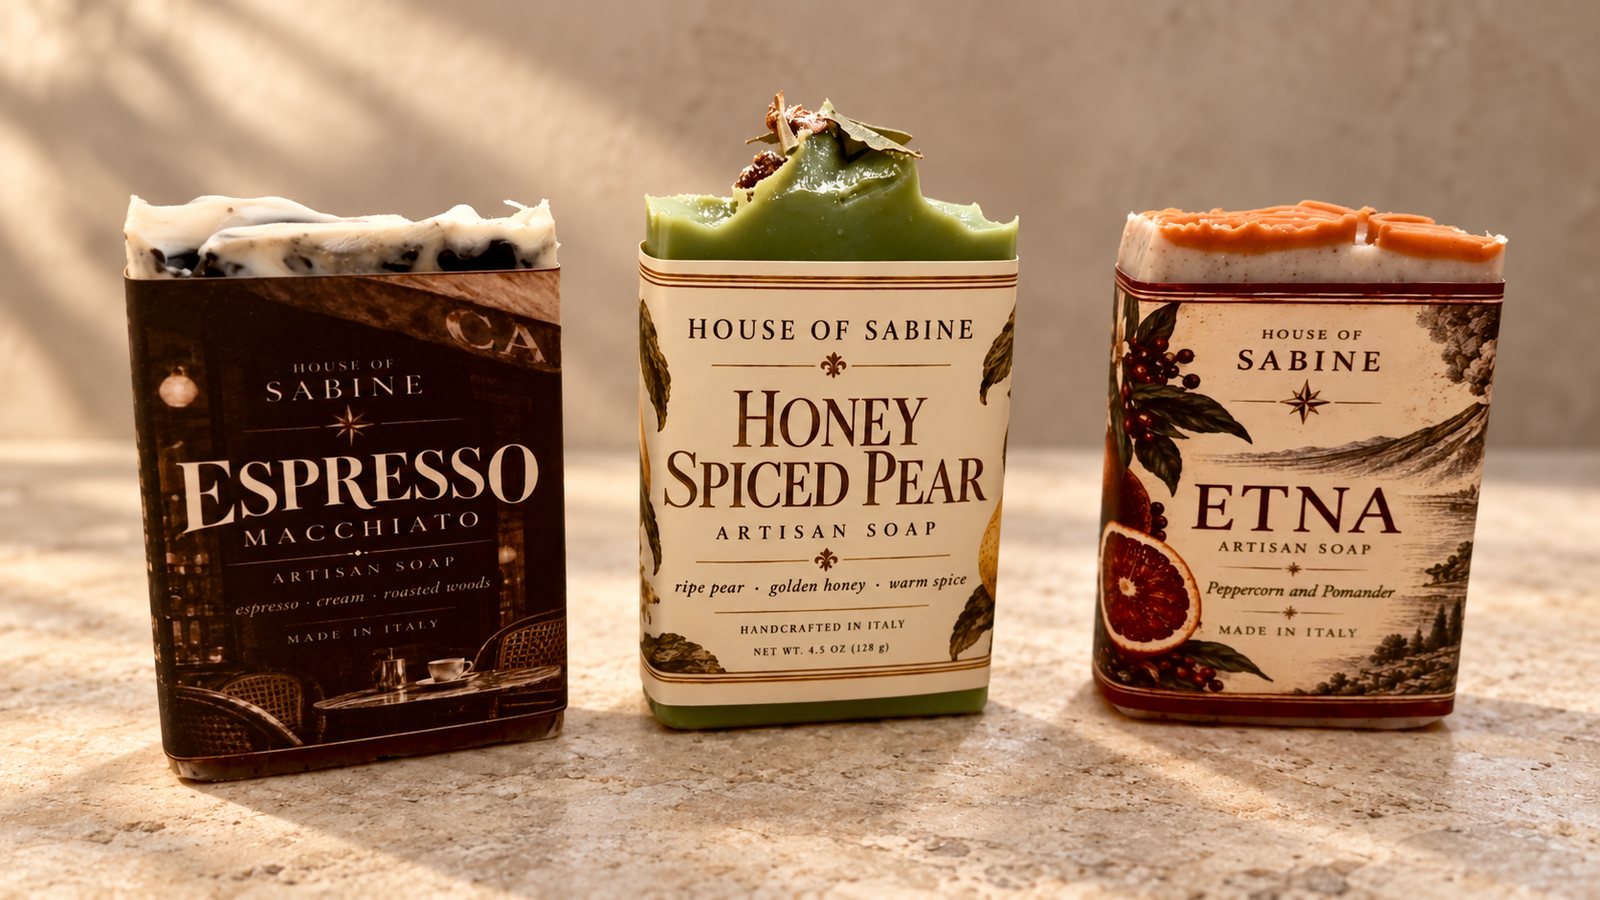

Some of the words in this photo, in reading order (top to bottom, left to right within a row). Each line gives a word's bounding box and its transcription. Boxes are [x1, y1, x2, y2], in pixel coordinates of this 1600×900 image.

[688, 318, 795, 340] HOUSE
[810, 320, 850, 340] OF
[865, 319, 974, 341] SABINE
[1262, 329, 1327, 340] HOUSE
[1337, 330, 1362, 341] OF
[293, 360, 361, 374] HOUSE
[370, 359, 396, 370] OF
[1237, 349, 1381, 372] SABINE
[265, 375, 424, 402] SABINE
[732, 390, 928, 447] HONEY
[176, 444, 539, 534] ESPRESSO
[664, 450, 849, 509] SPICED
[862, 451, 987, 506] PEAR
[1191, 483, 1402, 534] ETNA
[244, 511, 479, 548] MACCHIATO
[715, 524, 846, 540] ARTISAN
[867, 522, 937, 537] SOAP
[1218, 541, 1307, 554] ARTISAN
[1319, 542, 1372, 555] SOAP
[272, 563, 381, 585] ARTISAN
[396, 556, 456, 573] SOAP
[674, 580, 705, 596] ripe
[709, 582, 745, 596] pear
[769, 578, 818, 597] golden
[824, 578, 866, 594] honey
[889, 576, 928, 588] warm
[933, 573, 967, 588] spice
[1206, 581, 1285, 599] Peppercorn
[1289, 583, 1318, 598] and
[1321, 585, 1395, 599] Pomander
[235, 598, 300, 618] espresso
[316, 593, 365, 607] cream
[383, 581, 440, 600] roasted
[446, 576, 491, 592] woods
[287, 628, 341, 644] MADE
[353, 626, 373, 637] IN
[384, 619, 439, 634] ITALY
[740, 623, 841, 634] HANDCRAFTED
[847, 621, 862, 631] IN
[868, 619, 906, 630] ITALY
[1218, 624, 1267, 636] MADE
[1277, 626, 1295, 637] IN
[1307, 627, 1358, 638] ITALY
[753, 646, 778, 656] NET
[782, 645, 803, 656] WT.
[808, 645, 826, 655] 4.5
[830, 644, 846, 654] OZ
[851, 643, 875, 655] (128
[878, 642, 890, 653] g)
